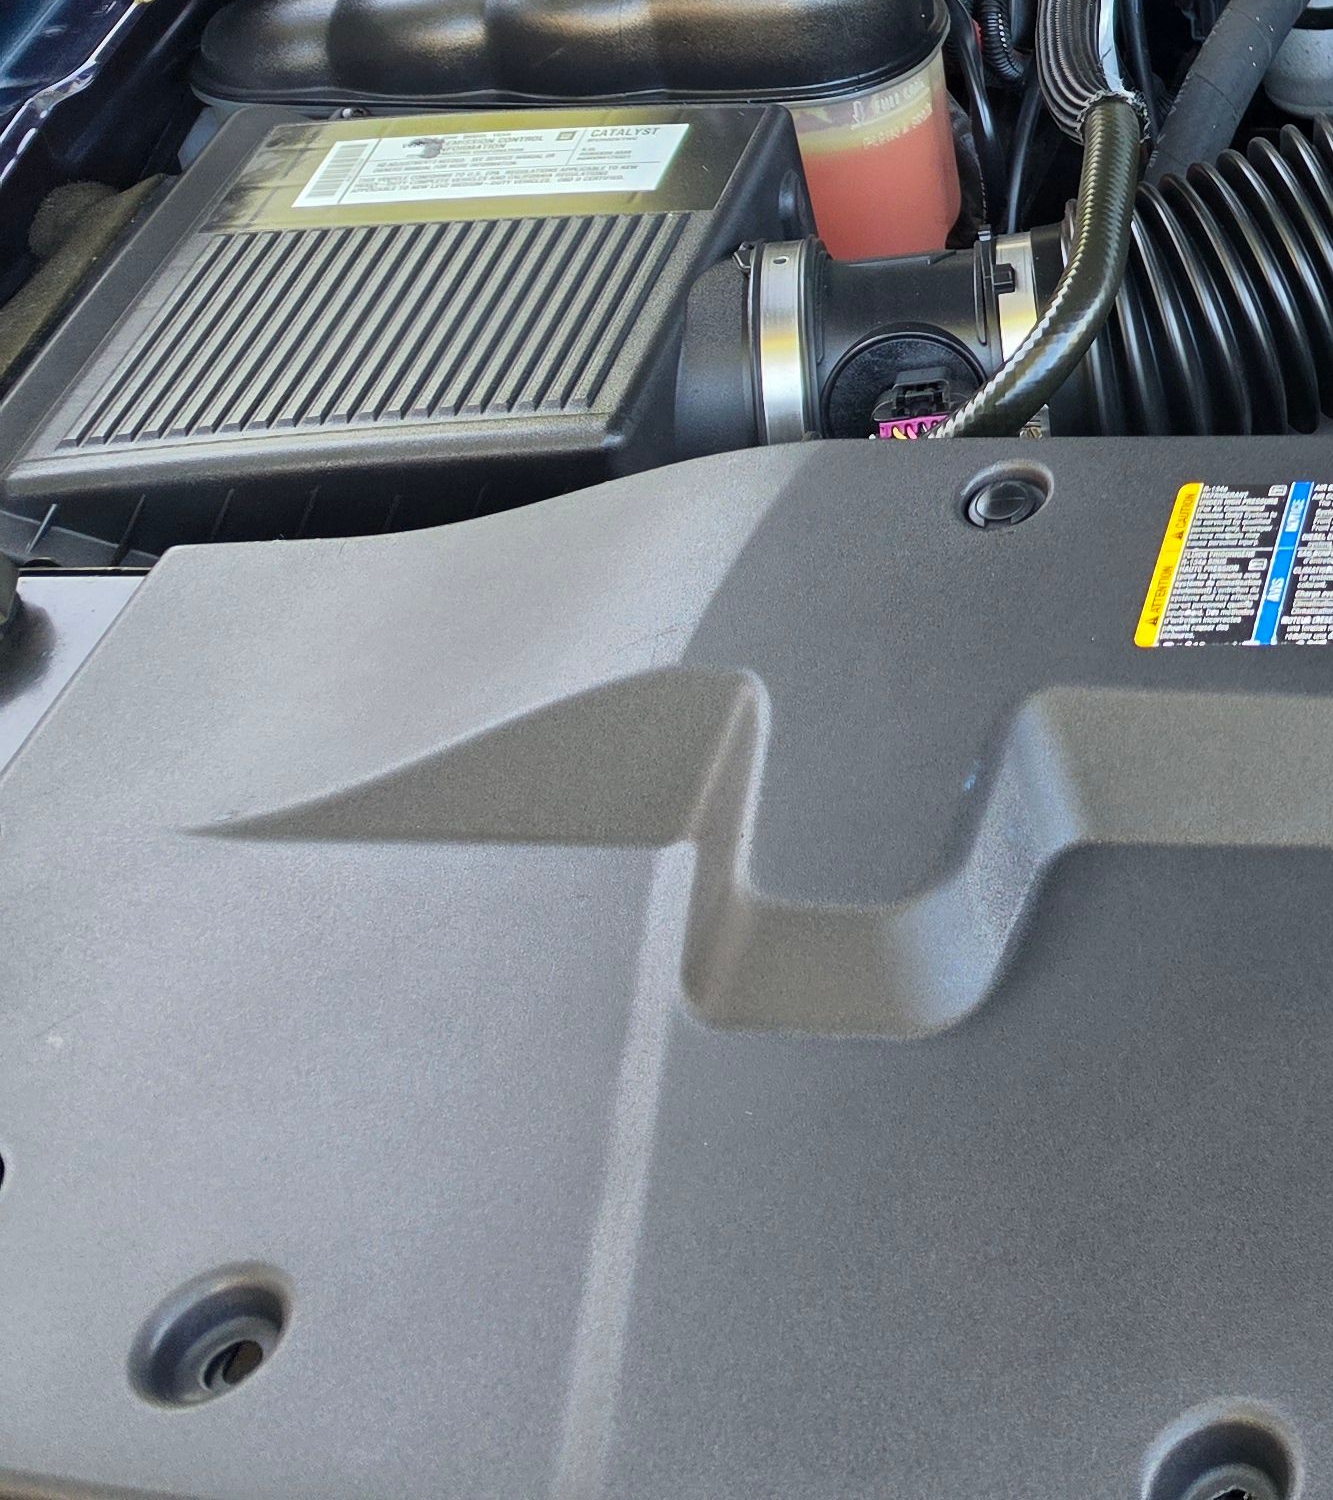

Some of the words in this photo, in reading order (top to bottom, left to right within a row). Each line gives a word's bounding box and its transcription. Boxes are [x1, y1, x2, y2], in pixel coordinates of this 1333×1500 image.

[498, 135, 545, 143] CONTROL
[590, 127, 660, 137] CATALYST
[1175, 493, 1195, 529] CAUTION
[1152, 565, 1174, 613] ATTENTION
